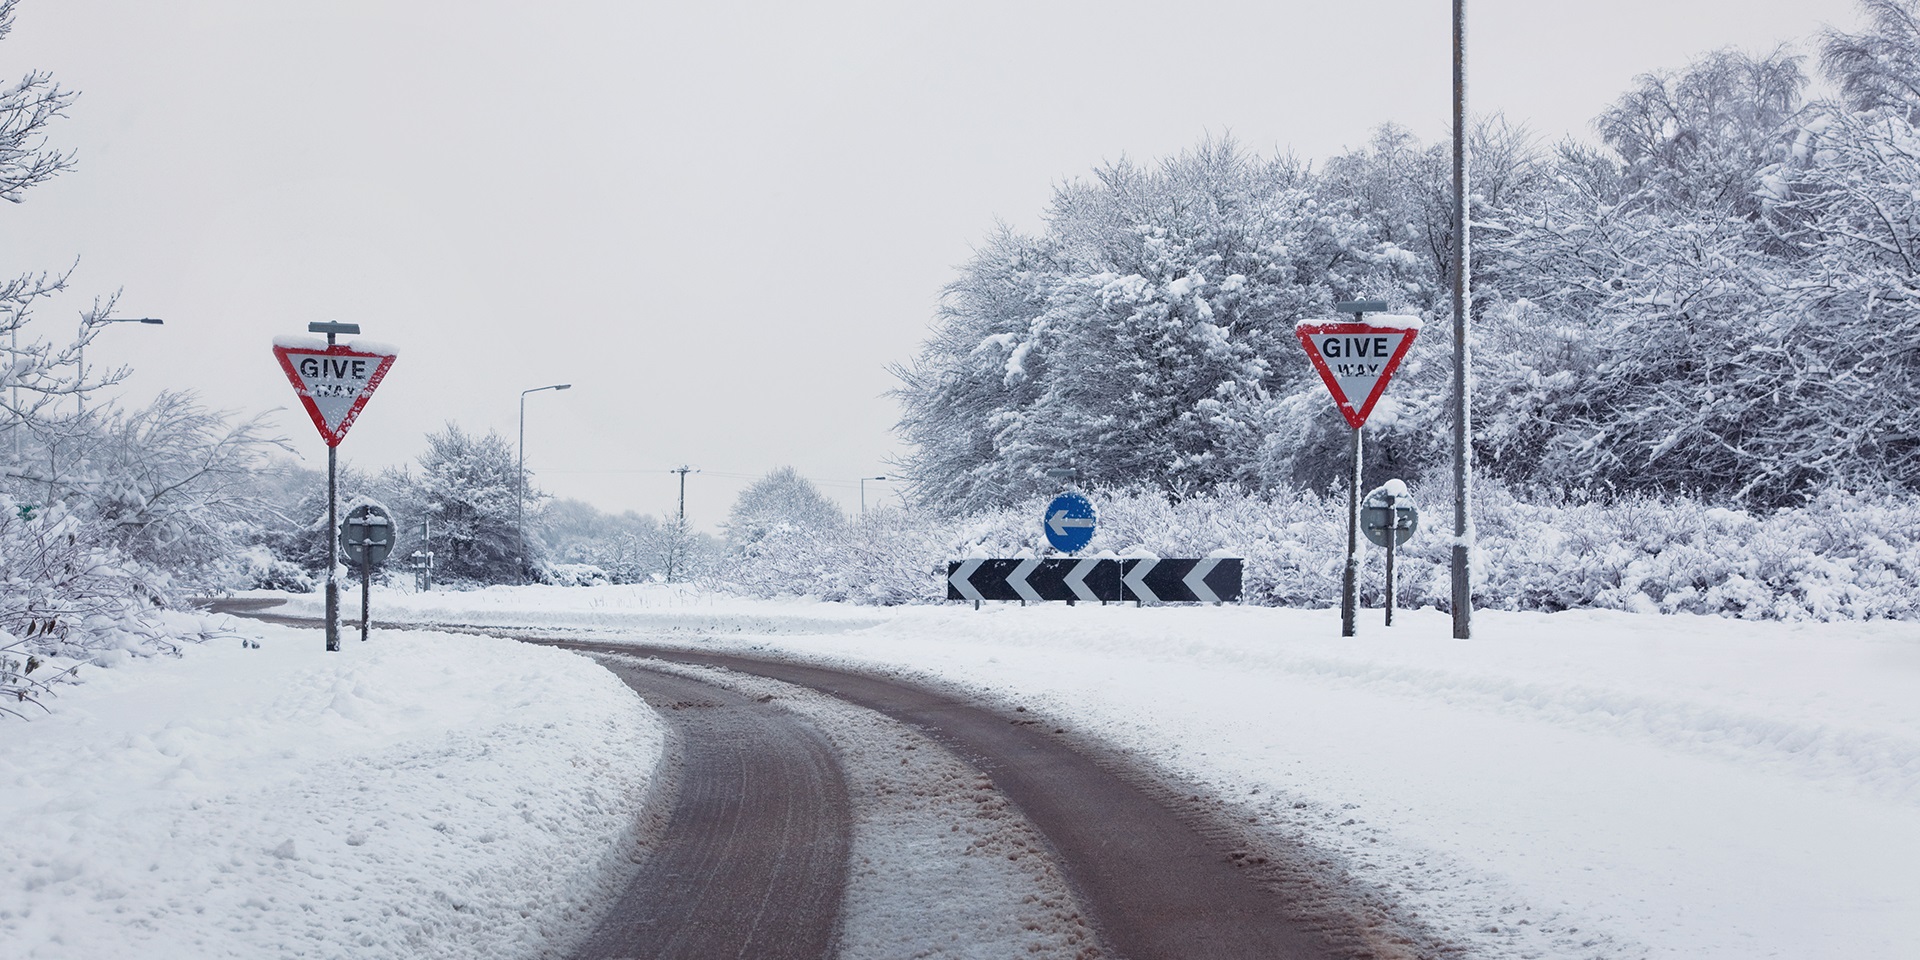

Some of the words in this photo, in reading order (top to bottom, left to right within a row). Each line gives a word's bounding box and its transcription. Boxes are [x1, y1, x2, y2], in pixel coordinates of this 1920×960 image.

[1323, 337, 1388, 358] GIVE
[300, 358, 366, 379] GIVE
[1338, 364, 1379, 377] WAY
